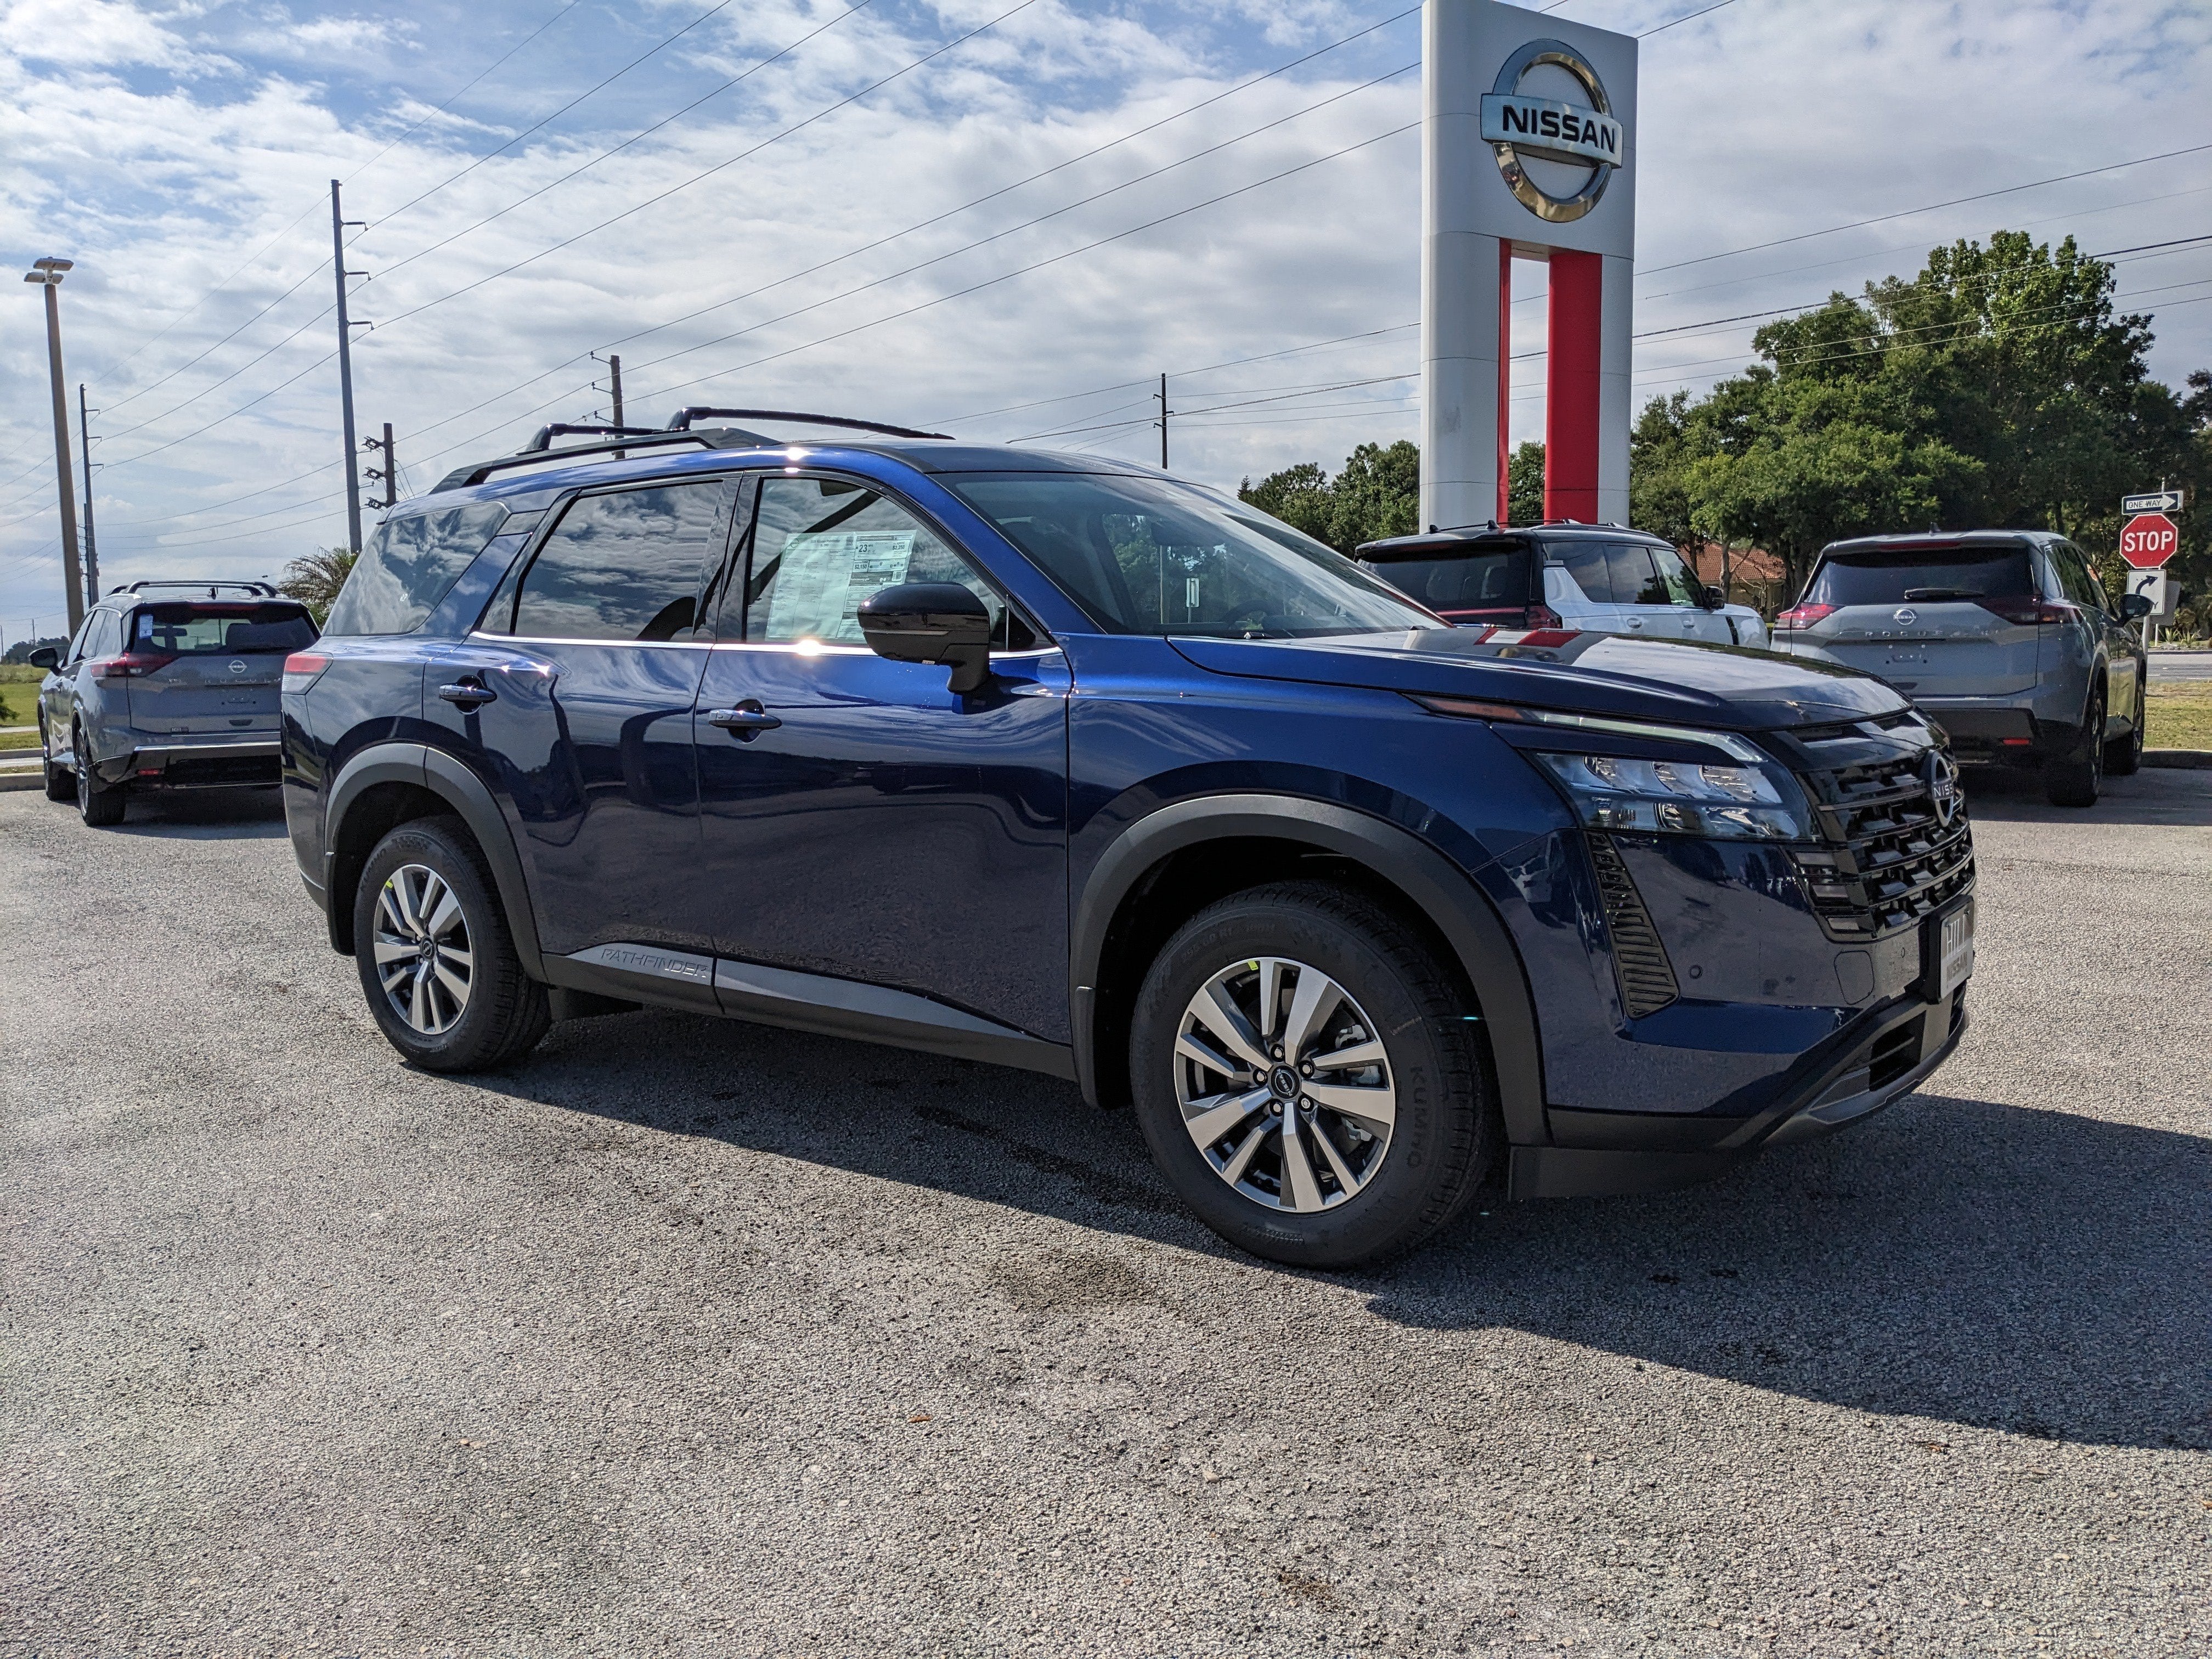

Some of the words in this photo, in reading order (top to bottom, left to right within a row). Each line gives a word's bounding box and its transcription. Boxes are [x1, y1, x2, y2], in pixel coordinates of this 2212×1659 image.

[1502, 105, 1615, 154] NISSAN
[859, 544, 867, 553] 23
[2124, 531, 2173, 552] STOP
[1933, 783, 1954, 797] NISS
[601, 948, 708, 978] PATHFINDER
[1407, 1065, 1429, 1169] KUMHO
